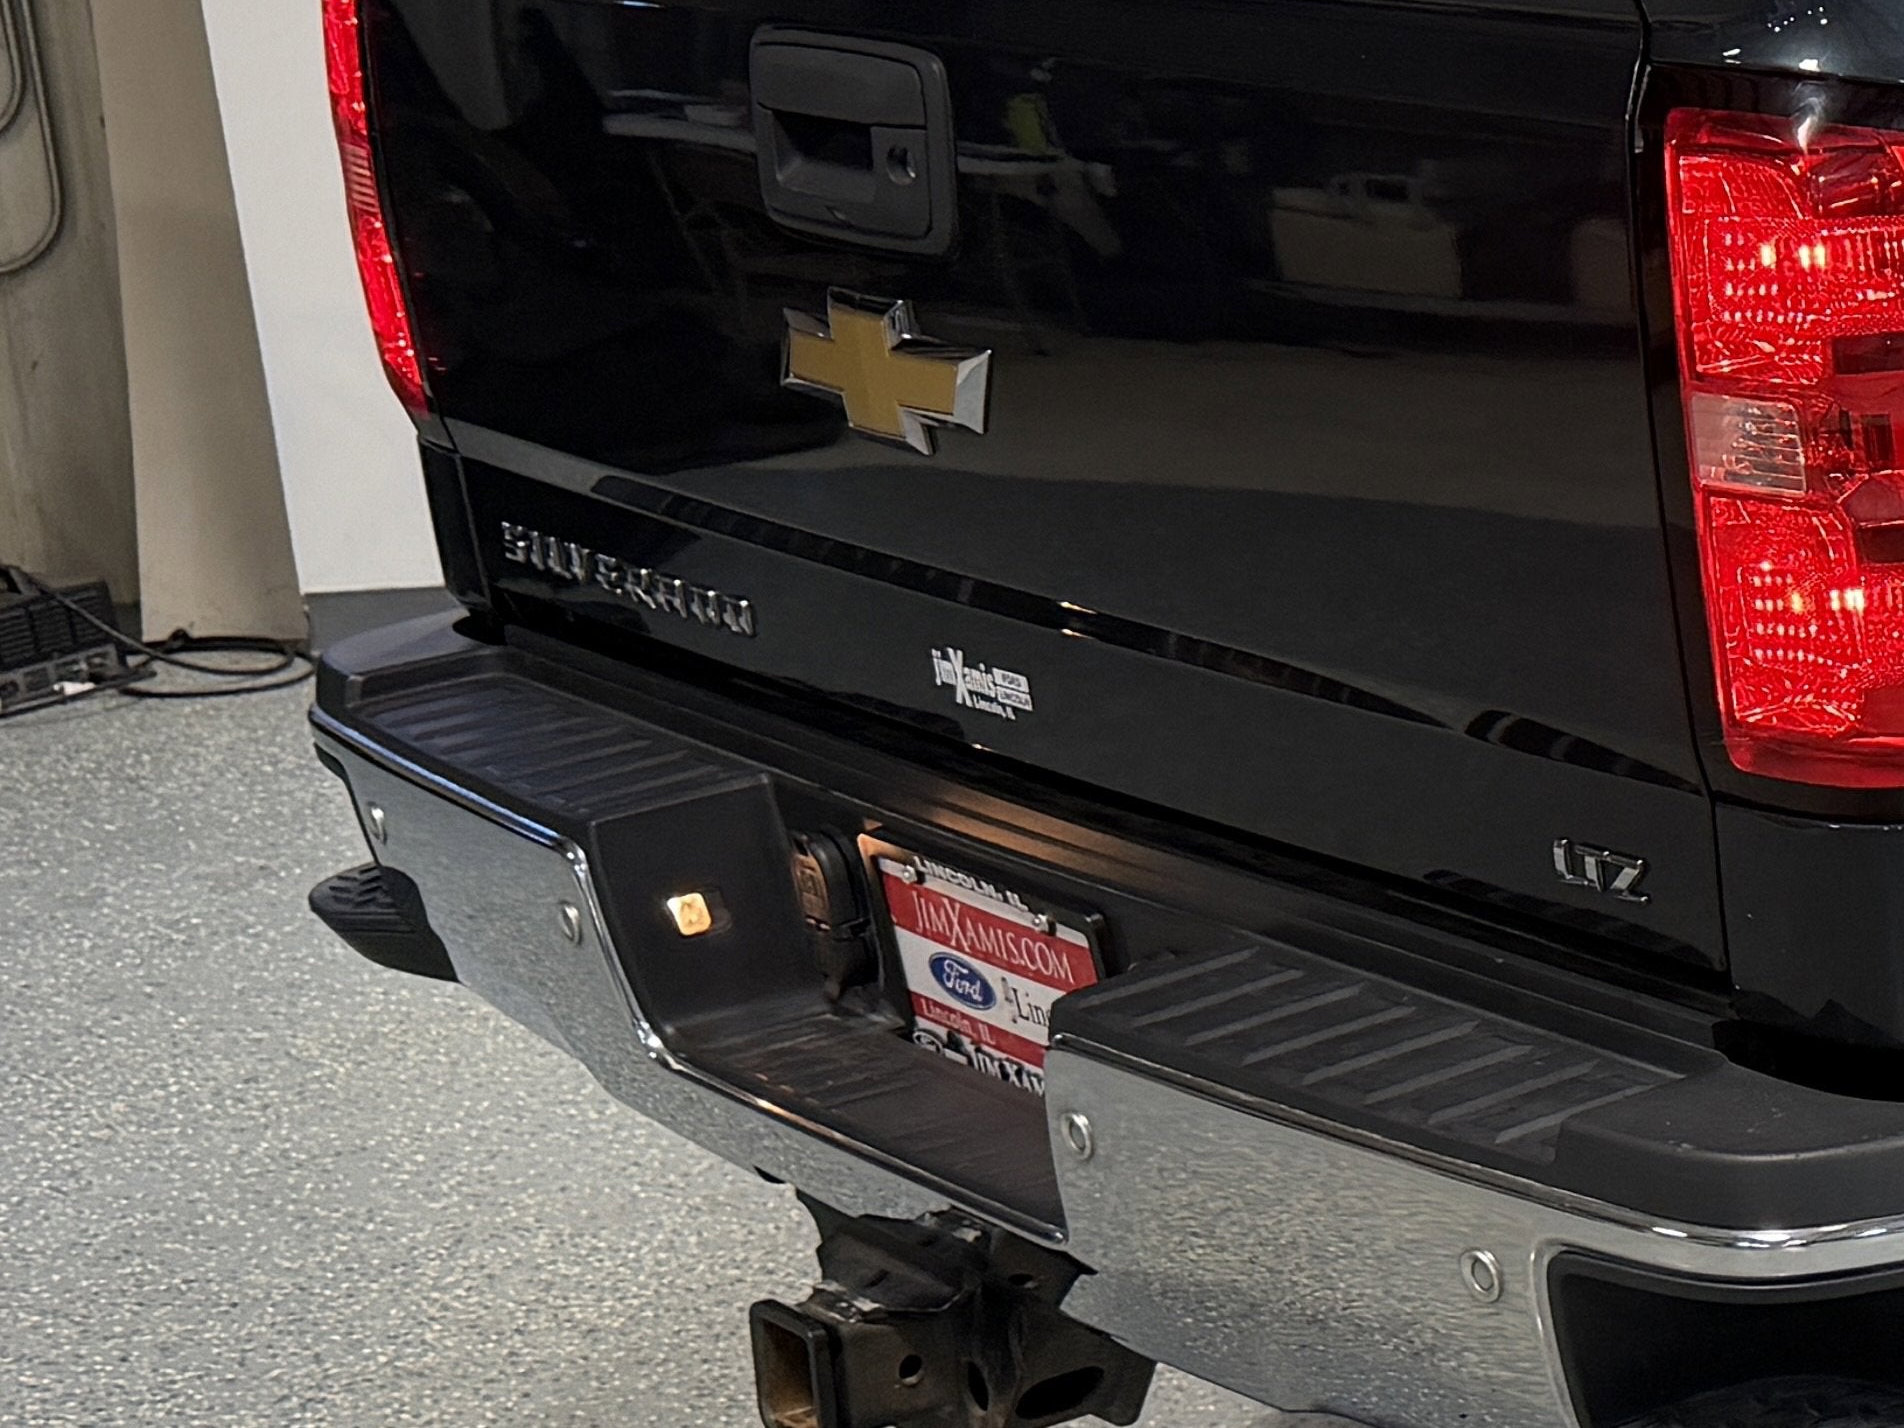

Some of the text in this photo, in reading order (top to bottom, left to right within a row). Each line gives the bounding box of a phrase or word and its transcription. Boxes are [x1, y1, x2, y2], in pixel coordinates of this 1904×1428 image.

[1552, 838, 1651, 905] LTZ
[911, 890, 1076, 986] JIMXAMIS.COM
[1011, 987, 1051, 1028] Lin
